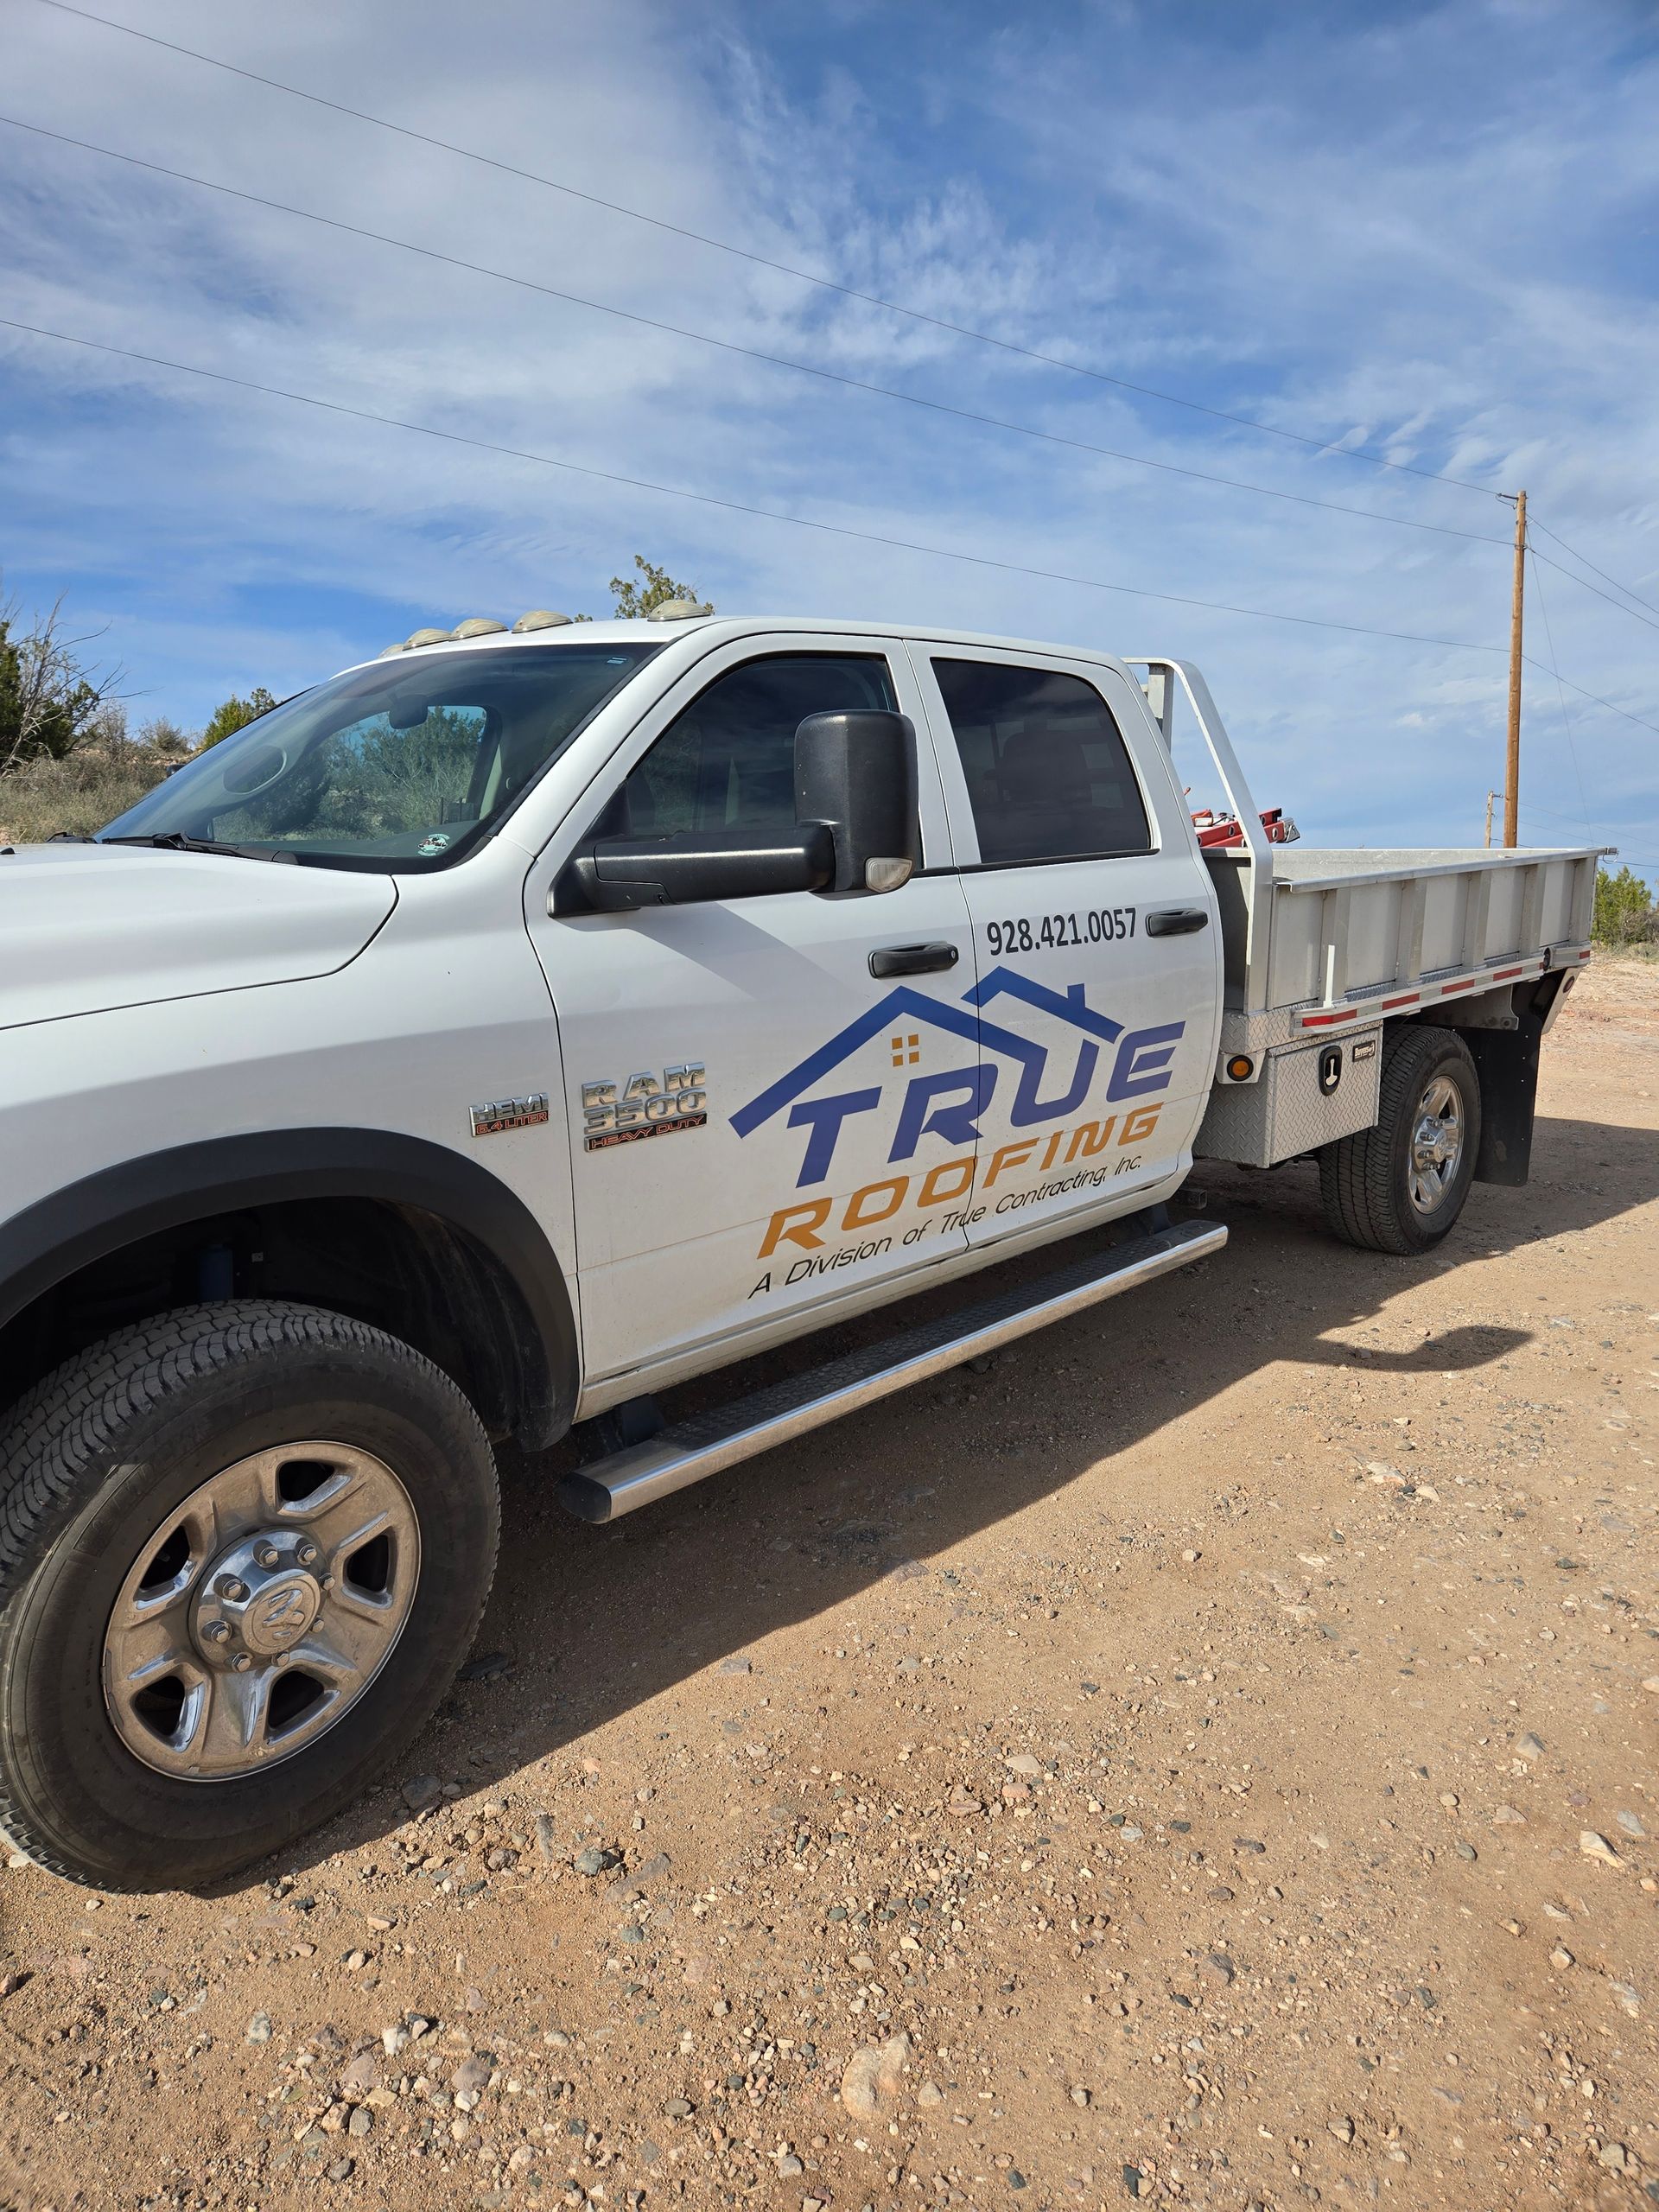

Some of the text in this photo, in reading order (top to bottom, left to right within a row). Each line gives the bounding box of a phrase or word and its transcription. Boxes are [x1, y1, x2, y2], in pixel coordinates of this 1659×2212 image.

[987, 907, 1136, 956] 928.421.0057
[468, 1092, 550, 1124] HEMI
[582, 1062, 705, 1109] RAM
[785, 1020, 1185, 1188] TRUE
[476, 1111, 548, 1135] 6.4 LITER
[584, 1088, 706, 1135] 3500
[591, 1115, 705, 1148] HEAVY DUTY
[757, 1102, 1164, 1259] ROOFING
[747, 1154, 1141, 1300] A Division of True Contracting, Inc.
